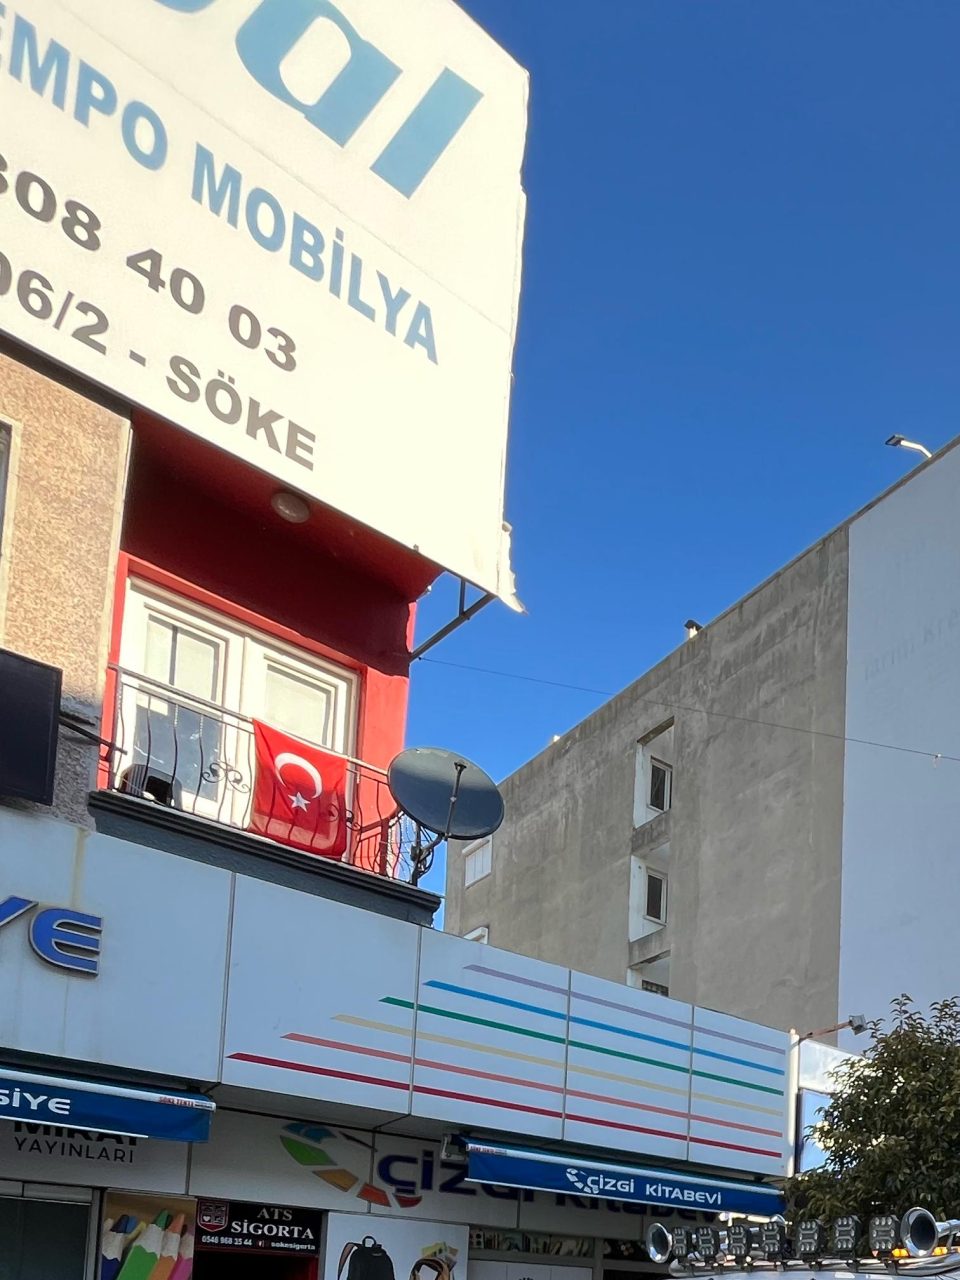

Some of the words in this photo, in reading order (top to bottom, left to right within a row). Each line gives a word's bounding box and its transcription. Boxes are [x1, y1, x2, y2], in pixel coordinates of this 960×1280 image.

[0, 5, 168, 171] MPO
[191, 142, 439, 365] MOBİLYA
[126, 248, 205, 314] 40
[228, 304, 297, 372] 03
[166, 355, 316, 472] SÖKE
[14, 1136, 134, 1164] YAYINLARI
[586, 1174, 635, 1194] ÇİZGİ
[645, 1183, 722, 1205] KİTABEVİ
[230, 1219, 315, 1240] SİGORTA
[256, 1207, 293, 1221] ATS
